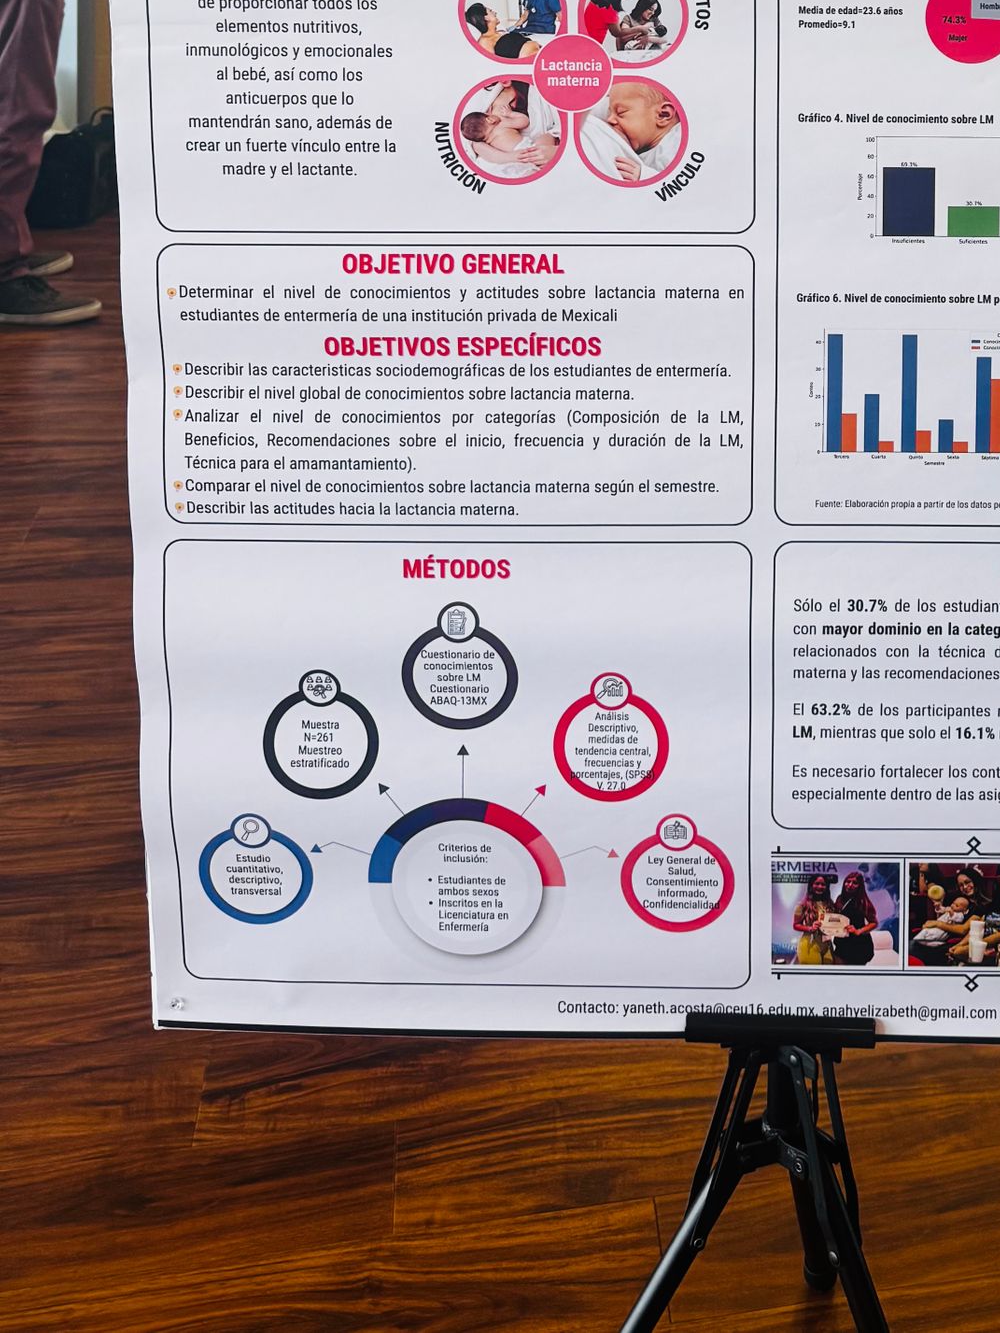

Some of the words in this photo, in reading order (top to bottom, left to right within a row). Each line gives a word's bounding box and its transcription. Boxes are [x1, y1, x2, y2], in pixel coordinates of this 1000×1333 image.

[798, 19, 855, 29] Promedio=9.1
[942, 15, 967, 24] 74.3%
[540, 58, 603, 73] Lactancia
[547, 74, 600, 87] materna
[434, 121, 487, 195] NUTRICIÓN
[654, 151, 706, 202] VÍNCULO
[341, 252, 454, 274] OBJETIVO
[461, 252, 565, 274] GENERAL
[323, 336, 450, 356] OBJETIVOS
[457, 331, 601, 357] ESPECÍFICOS
[184, 454, 236, 469] Técnica
[240, 458, 269, 472] para
[273, 455, 285, 470] el
[289, 456, 416, 474] amamantamiento).
[402, 553, 510, 579] MÉTODOS
[793, 597, 822, 612] Sólo
[828, 598, 840, 612] el
[846, 598, 887, 612] 30.7%
[894, 598, 910, 612] de
[916, 597, 936, 612] los
[301, 719, 339, 730] Muestra
[303, 731, 333, 742] N=261
[290, 757, 349, 768] estratificado
[437, 842, 478, 852] Criterios
[479, 843, 491, 853] de
[443, 853, 487, 863] inclusión:
[557, 1000, 618, 1014] Contacto:
[822, 1004, 998, 1021] anahyelizabeth@gmail.com
